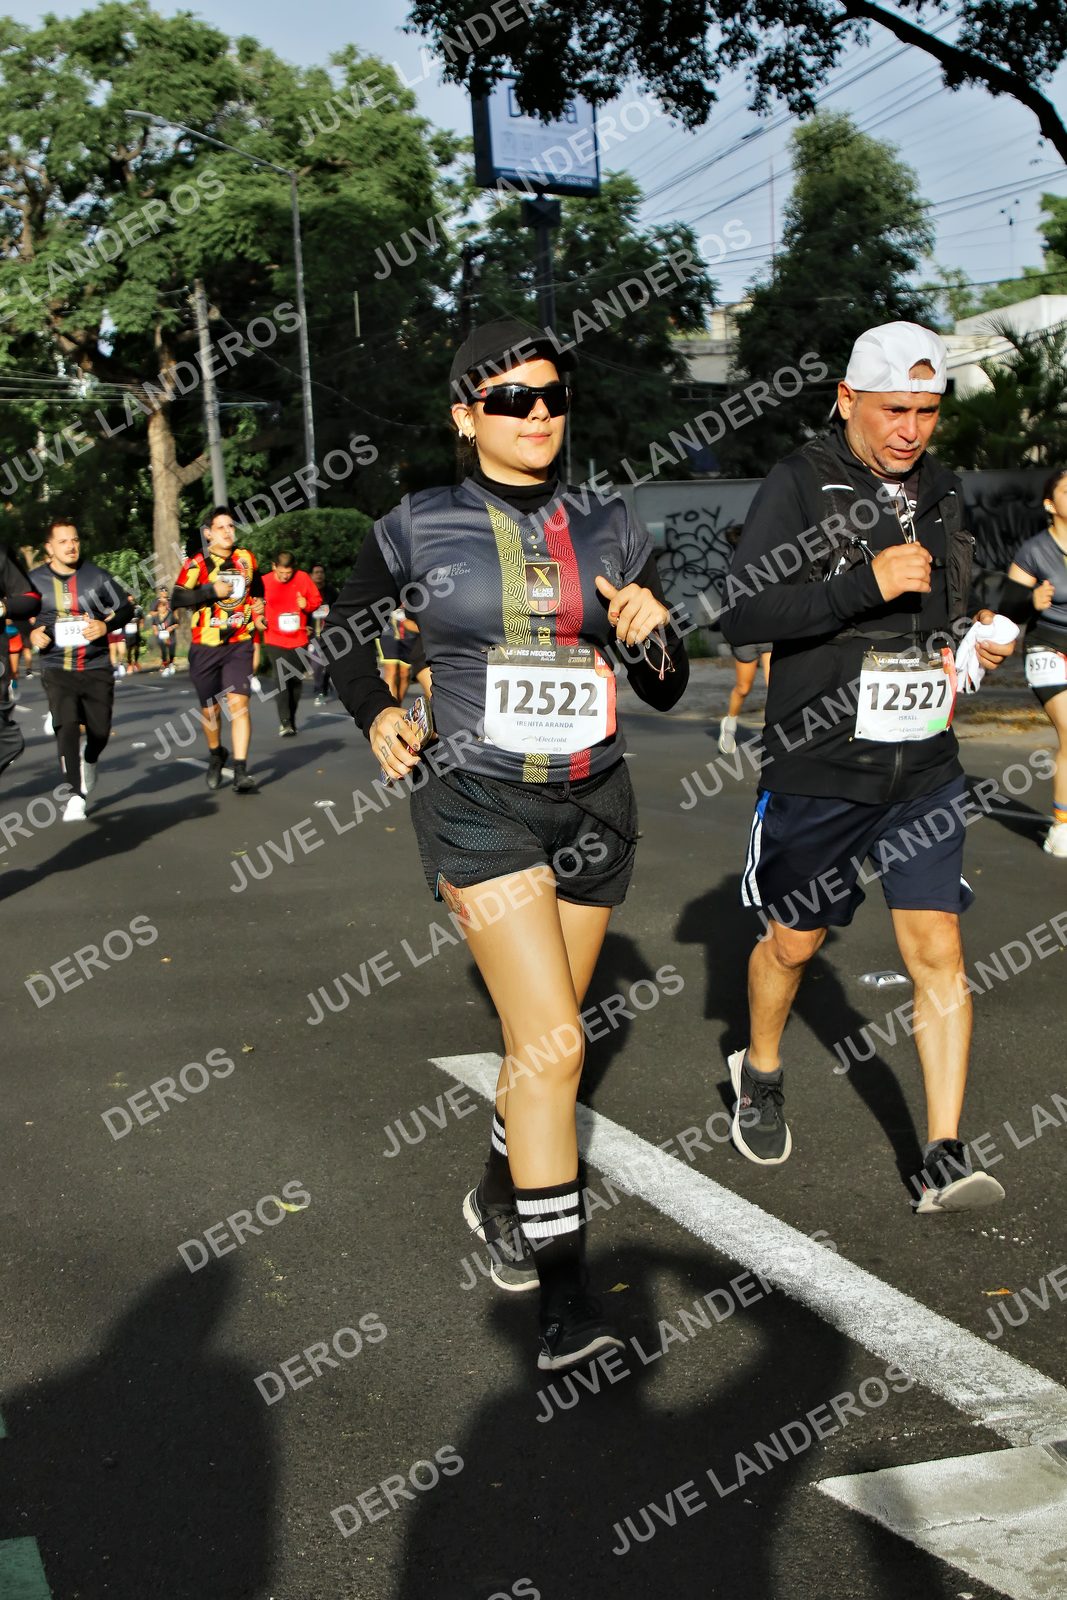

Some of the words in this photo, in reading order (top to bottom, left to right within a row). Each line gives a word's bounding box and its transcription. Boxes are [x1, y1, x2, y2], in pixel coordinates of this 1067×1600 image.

[665, 505, 721, 527] TOY
[1029, 656, 1056, 672] 9576
[494, 680, 598, 716] 12522
[867, 680, 946, 711] 12527
[516, 720, 544, 728] IRENITA
